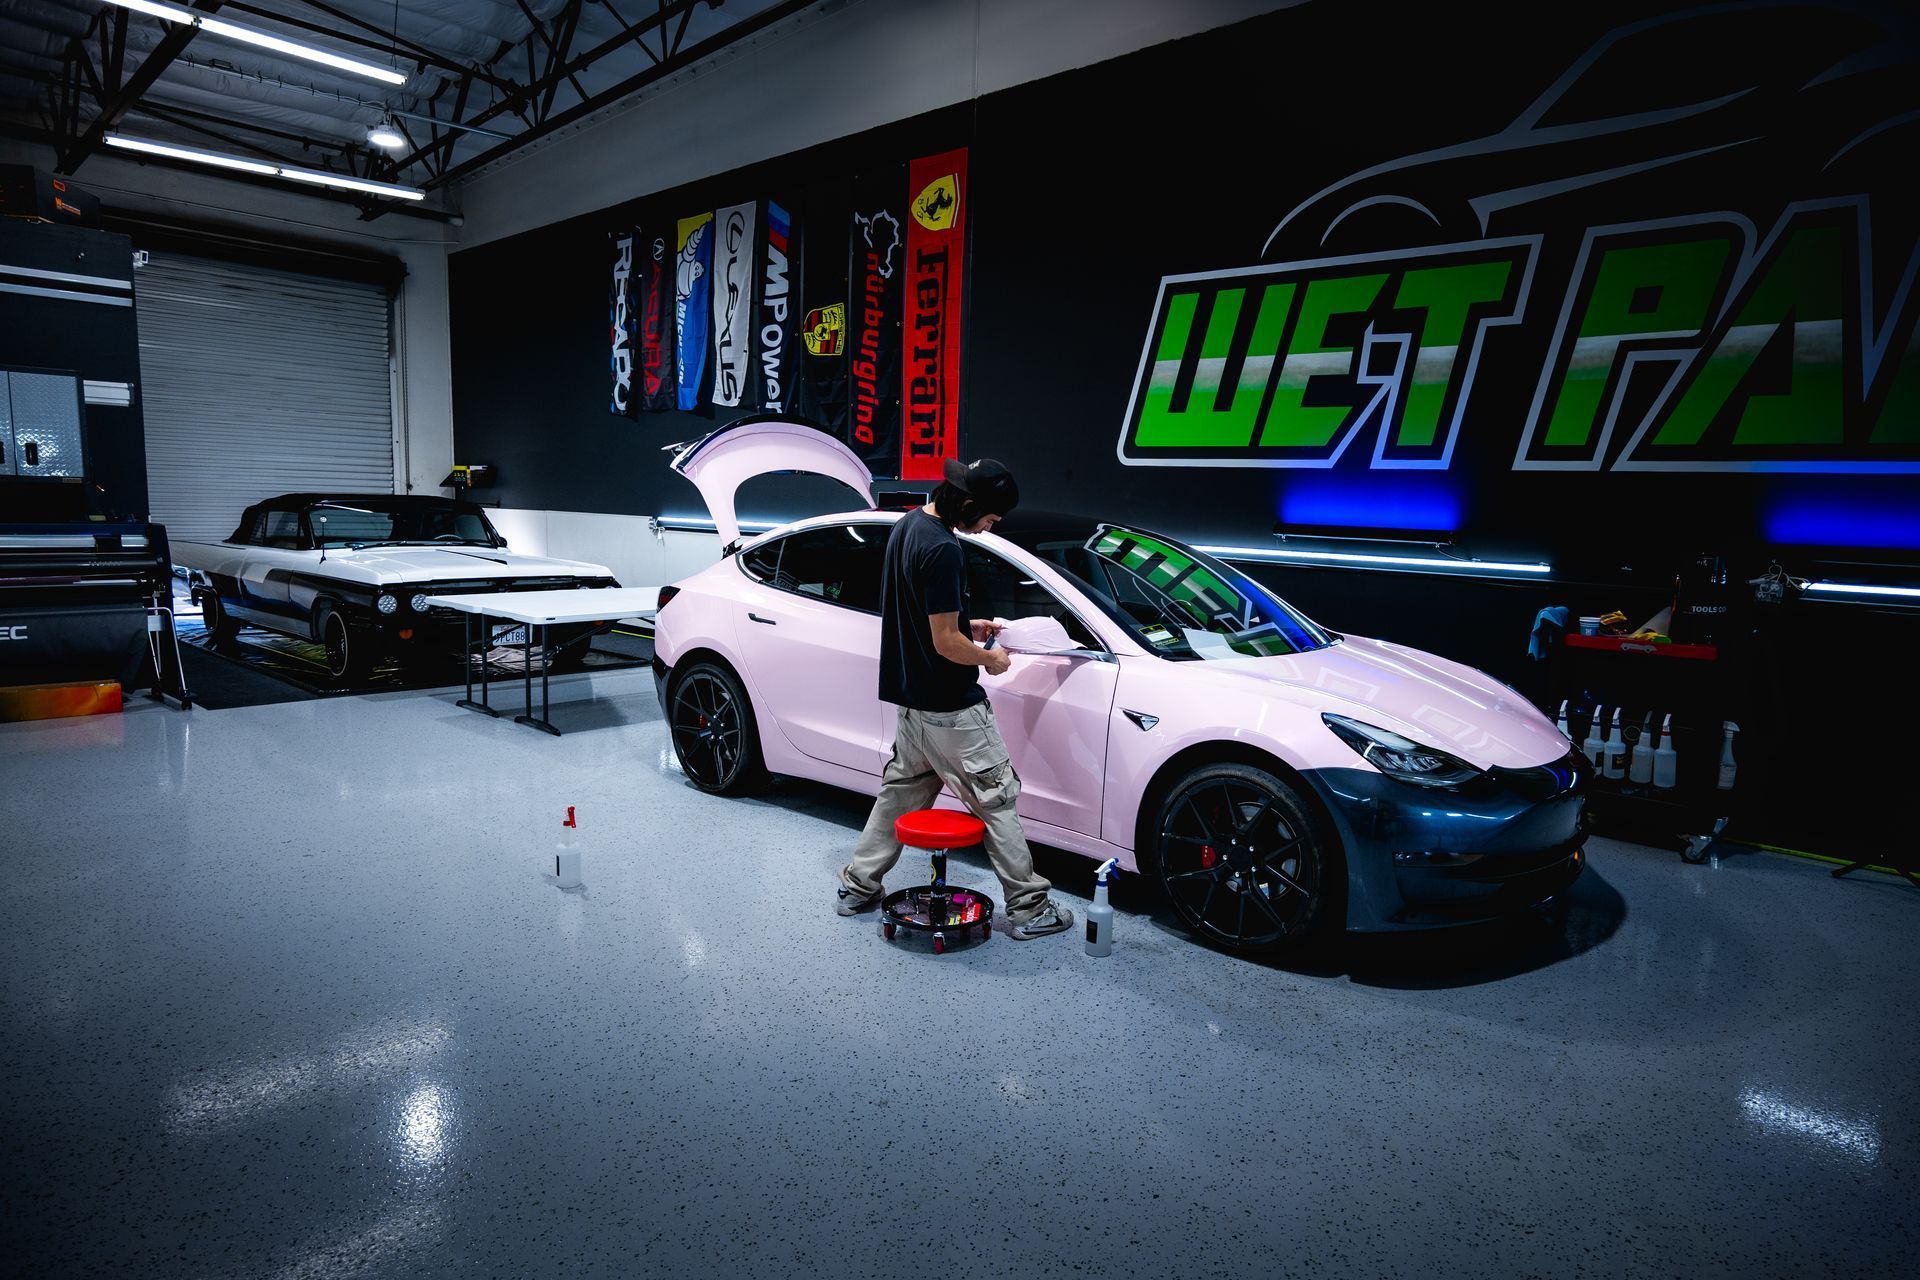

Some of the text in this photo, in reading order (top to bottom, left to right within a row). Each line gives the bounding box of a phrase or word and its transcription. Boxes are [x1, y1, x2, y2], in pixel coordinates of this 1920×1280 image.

[643, 263, 661, 396] ACURA
[719, 255, 738, 402] LEXUS
[852, 252, 886, 445] nürburgring
[910, 245, 949, 459] Ferrari
[1134, 258, 1515, 449] WET
